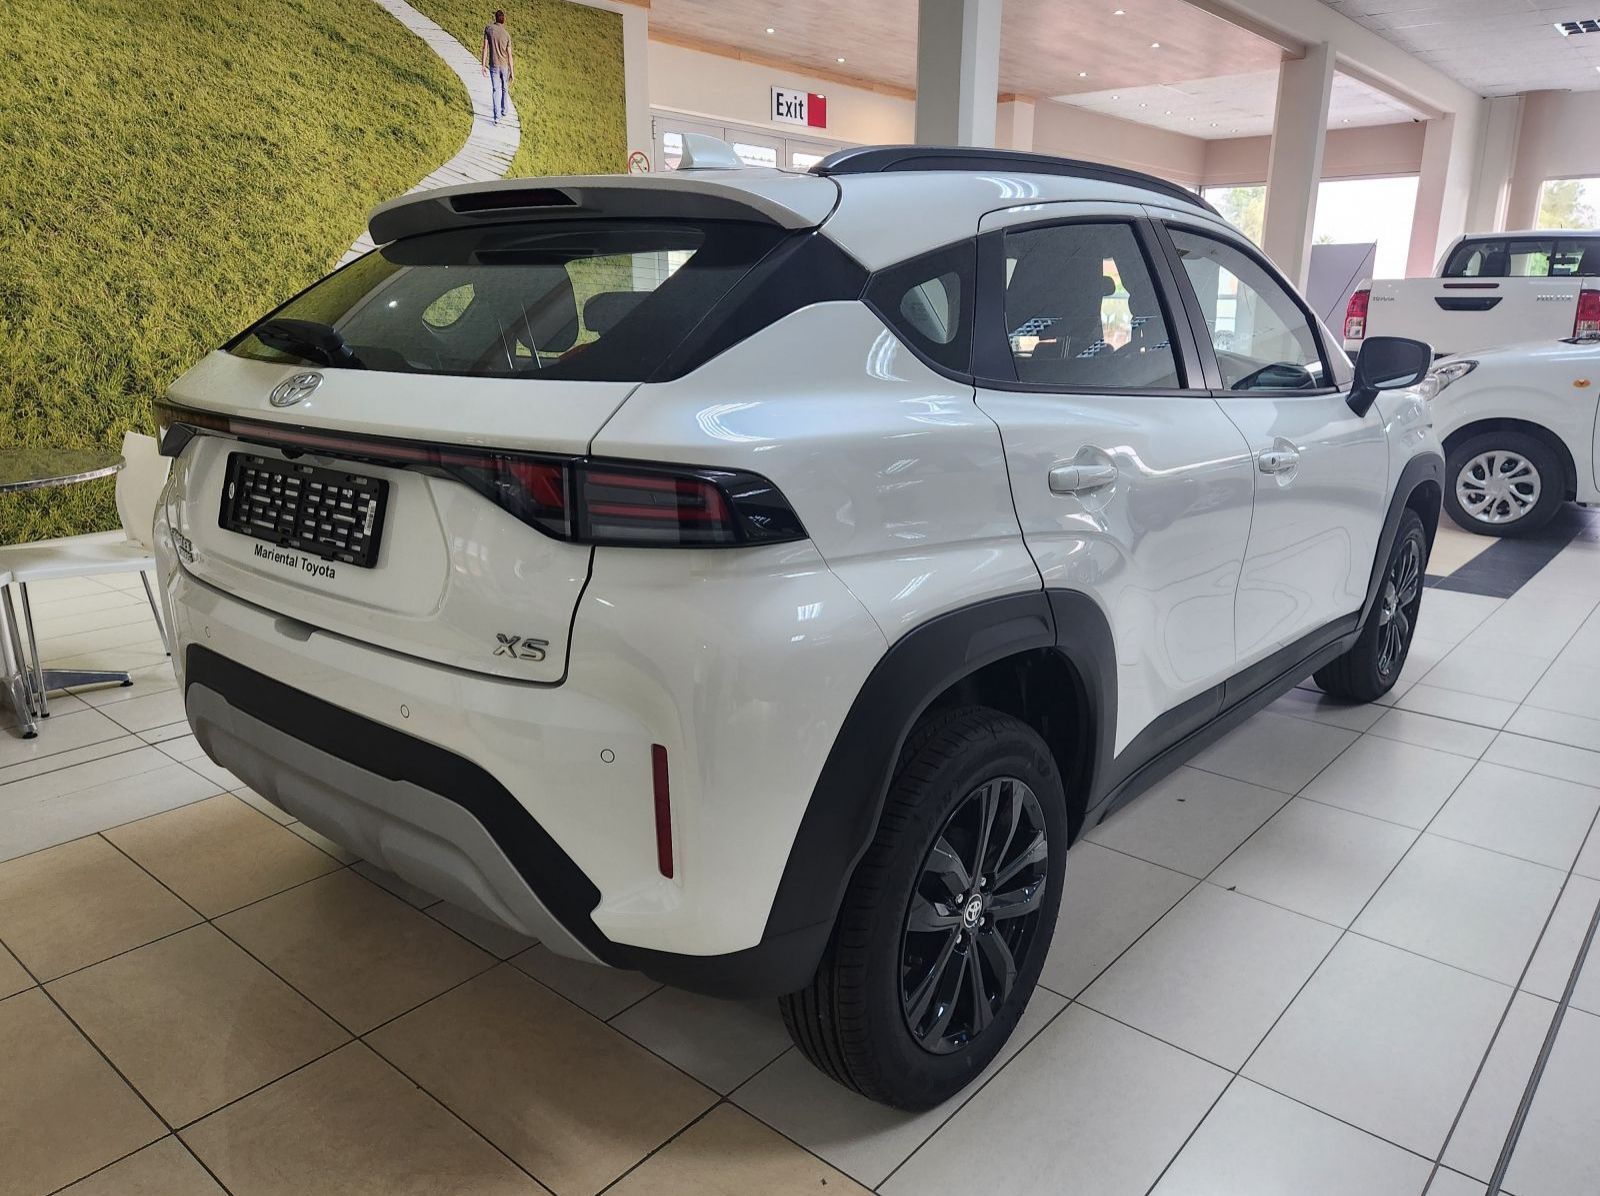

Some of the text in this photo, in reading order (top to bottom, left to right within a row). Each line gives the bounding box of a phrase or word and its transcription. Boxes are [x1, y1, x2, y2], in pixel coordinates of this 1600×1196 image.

[776, 92, 804, 120] Exit
[254, 543, 336, 579] Mariental Toyota
[493, 633, 549, 661] XS
